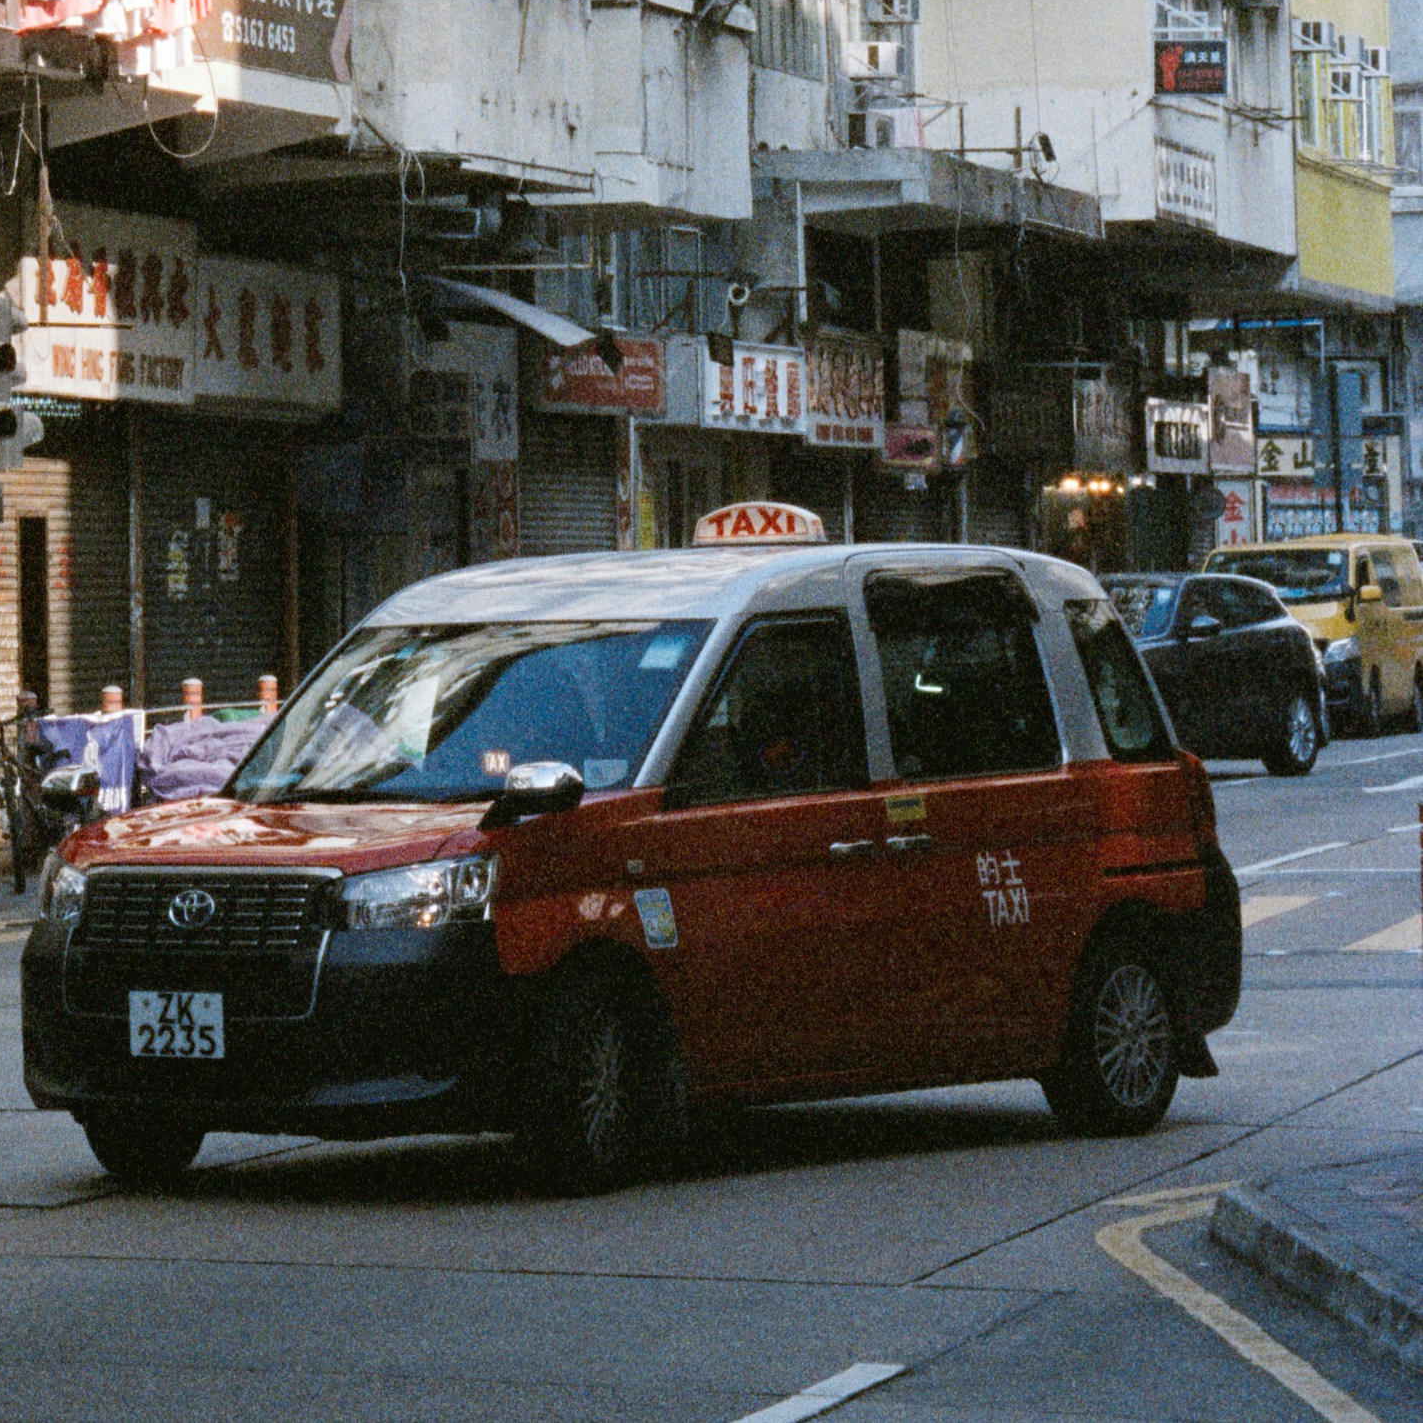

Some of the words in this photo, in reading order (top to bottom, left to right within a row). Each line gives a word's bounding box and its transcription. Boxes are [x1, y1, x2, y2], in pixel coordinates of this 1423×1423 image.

[235, 16, 264, 48] 5162
[268, 23, 296, 53] 6453
[707, 506, 796, 537] TAXI
[483, 752, 510, 774] TAXI
[977, 850, 1023, 886] 的士
[982, 887, 1030, 927] TAXI
[158, 993, 195, 1025] ZK
[138, 1024, 216, 1056] 2235
